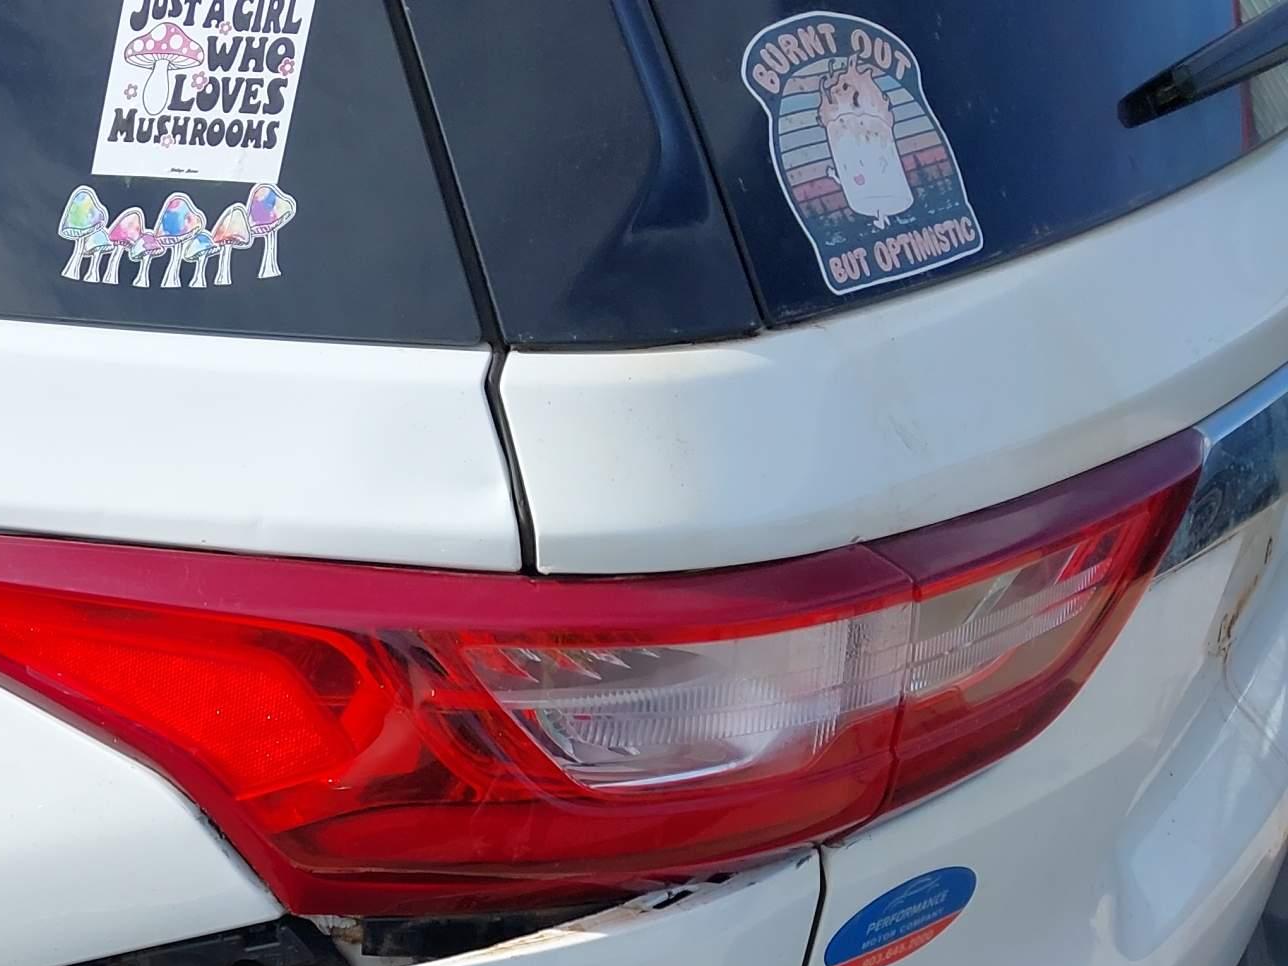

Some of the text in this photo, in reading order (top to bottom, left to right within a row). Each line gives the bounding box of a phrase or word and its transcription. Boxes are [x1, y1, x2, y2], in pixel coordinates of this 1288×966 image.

[130, 0, 303, 34] JUST A GIRL
[207, 36, 296, 73] WHO
[752, 23, 911, 94] BURNT OUT
[167, 74, 289, 115] LOVES
[107, 108, 280, 149] MUSHROOMS
[829, 216, 976, 284] BUT OPTIMISTIC
[866, 889, 950, 937] PERFORMANCE
